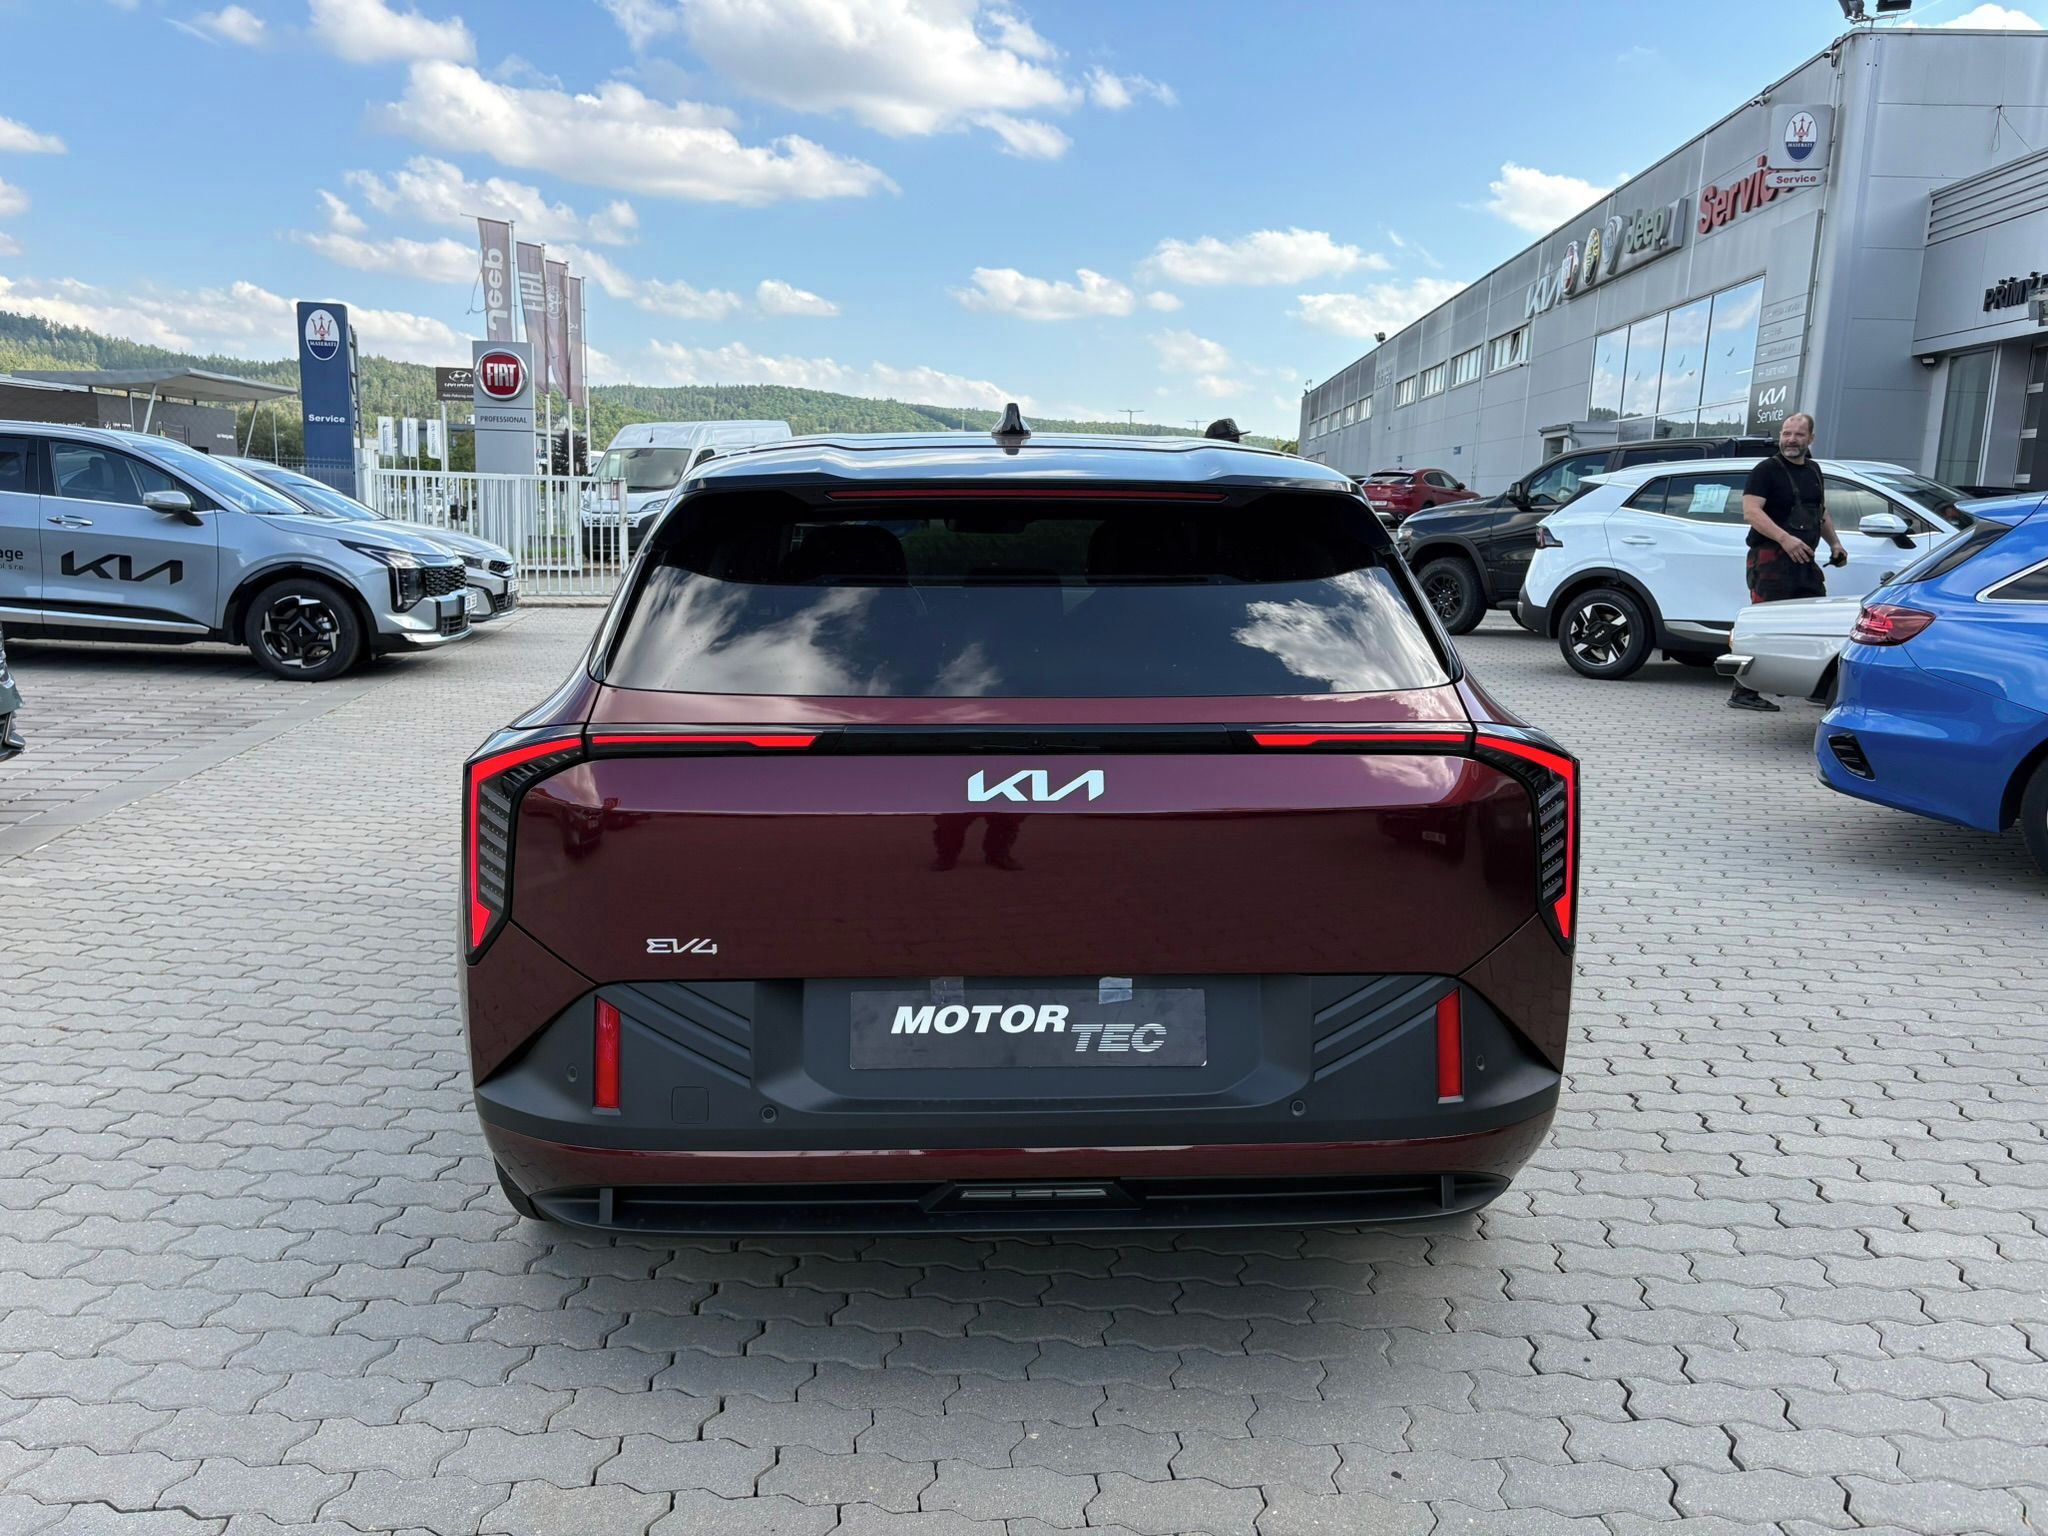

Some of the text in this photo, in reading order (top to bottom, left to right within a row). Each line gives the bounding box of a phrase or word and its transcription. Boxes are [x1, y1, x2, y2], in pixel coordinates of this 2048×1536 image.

[1776, 174, 1817, 184] Service
[1697, 154, 1796, 235] Servic
[486, 362, 517, 387] FIAT
[1758, 385, 1787, 407] KIA
[308, 413, 346, 423] Service
[480, 415, 527, 424] PROFESSIONAL
[1756, 407, 1784, 424] Service
[61, 550, 183, 585] KIA
[968, 769, 1104, 802] KIA
[646, 938, 718, 955] EV4
[890, 1004, 1069, 1034] MOTOR
